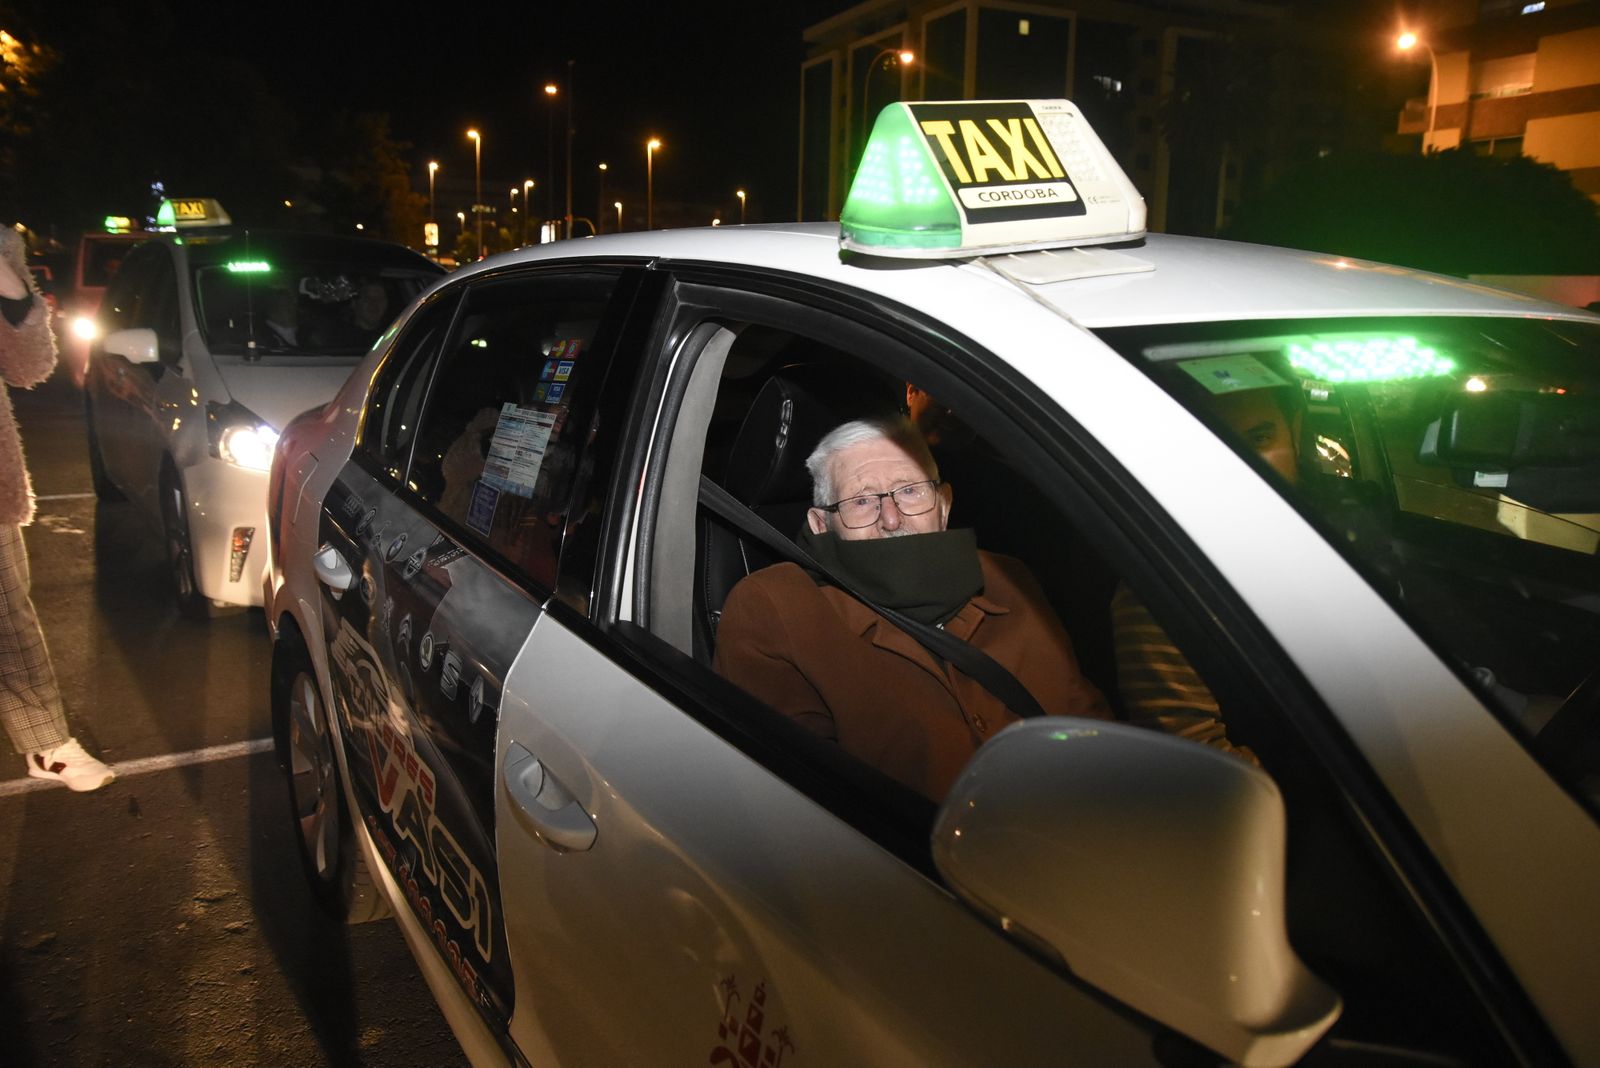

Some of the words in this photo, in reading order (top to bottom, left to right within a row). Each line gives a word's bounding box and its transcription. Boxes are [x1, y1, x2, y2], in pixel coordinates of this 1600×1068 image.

[920, 119, 1065, 183] TAXI
[978, 188, 1058, 203] CORDOBA
[173, 202, 205, 215] TAXI
